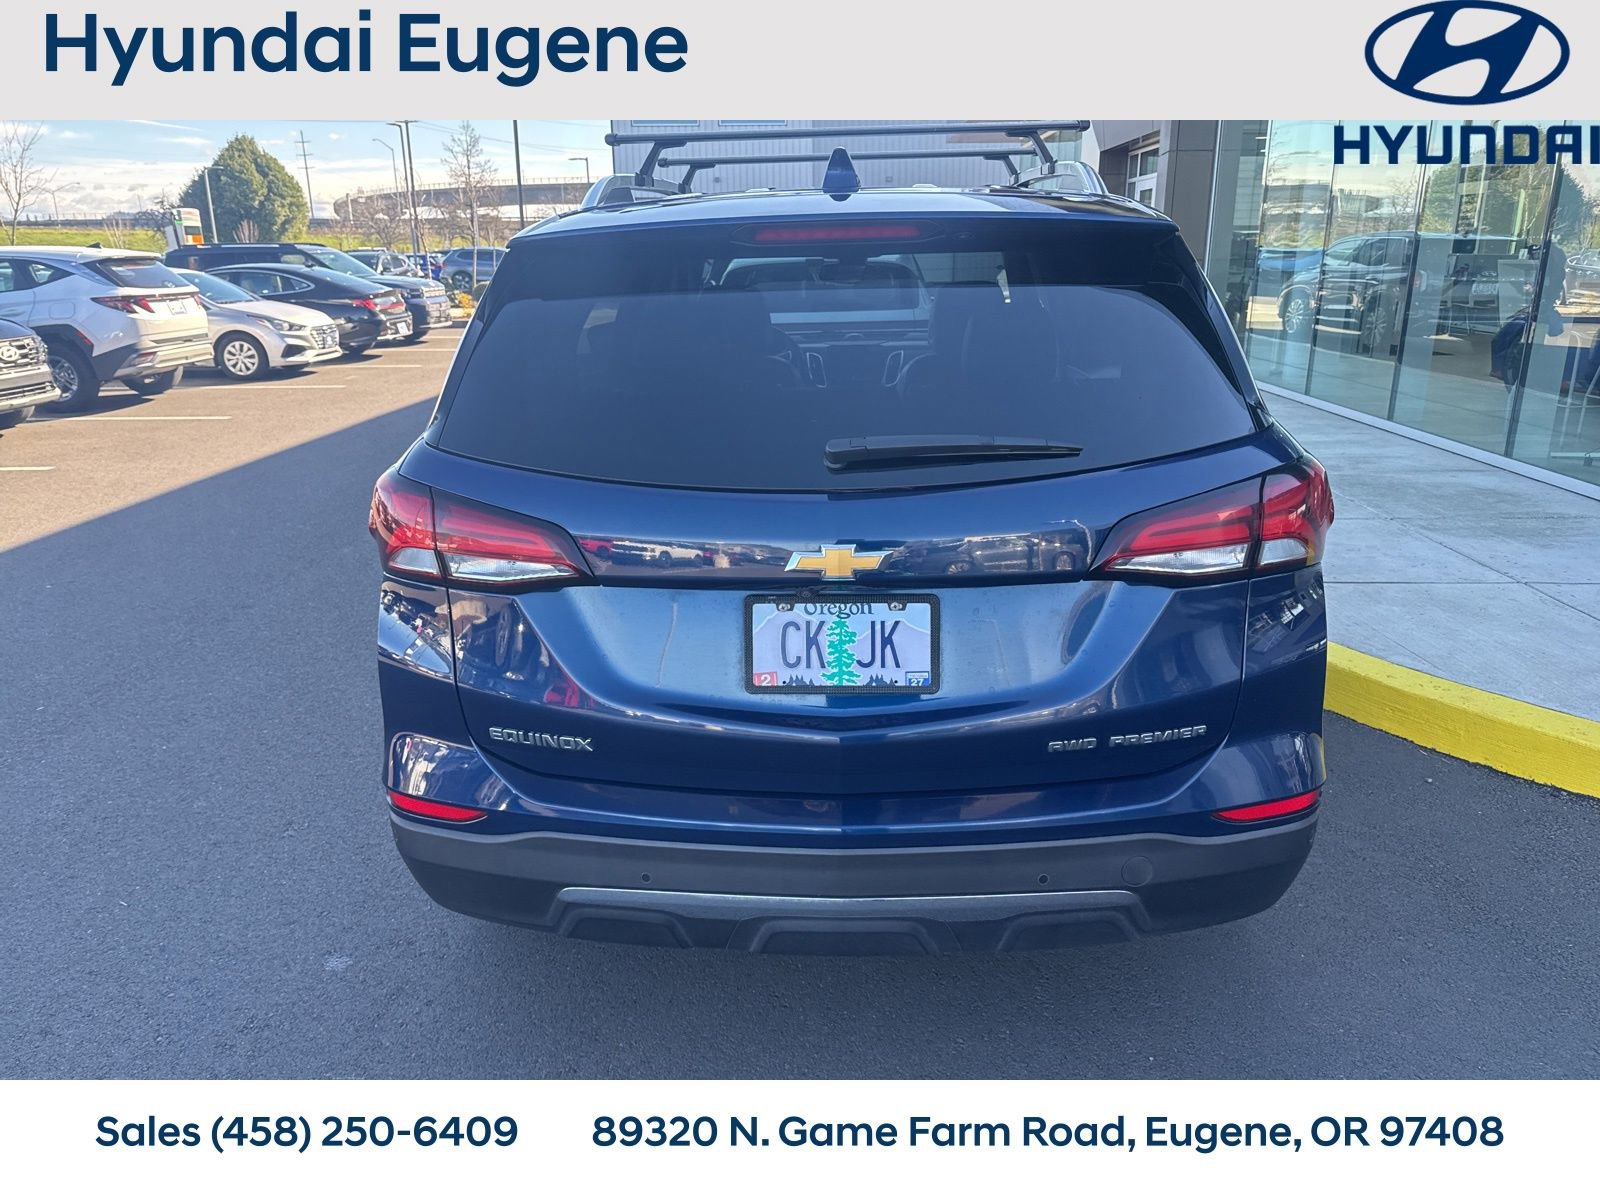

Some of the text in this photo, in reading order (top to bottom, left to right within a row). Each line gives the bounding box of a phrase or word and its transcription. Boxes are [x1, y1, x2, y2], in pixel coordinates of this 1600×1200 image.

[803, 602, 874, 619] Oregon
[760, 674, 771, 686] 2
[910, 678, 924, 686] 27
[489, 727, 593, 752] EQUINOX
[1048, 725, 1207, 752] AWD PREMIER
